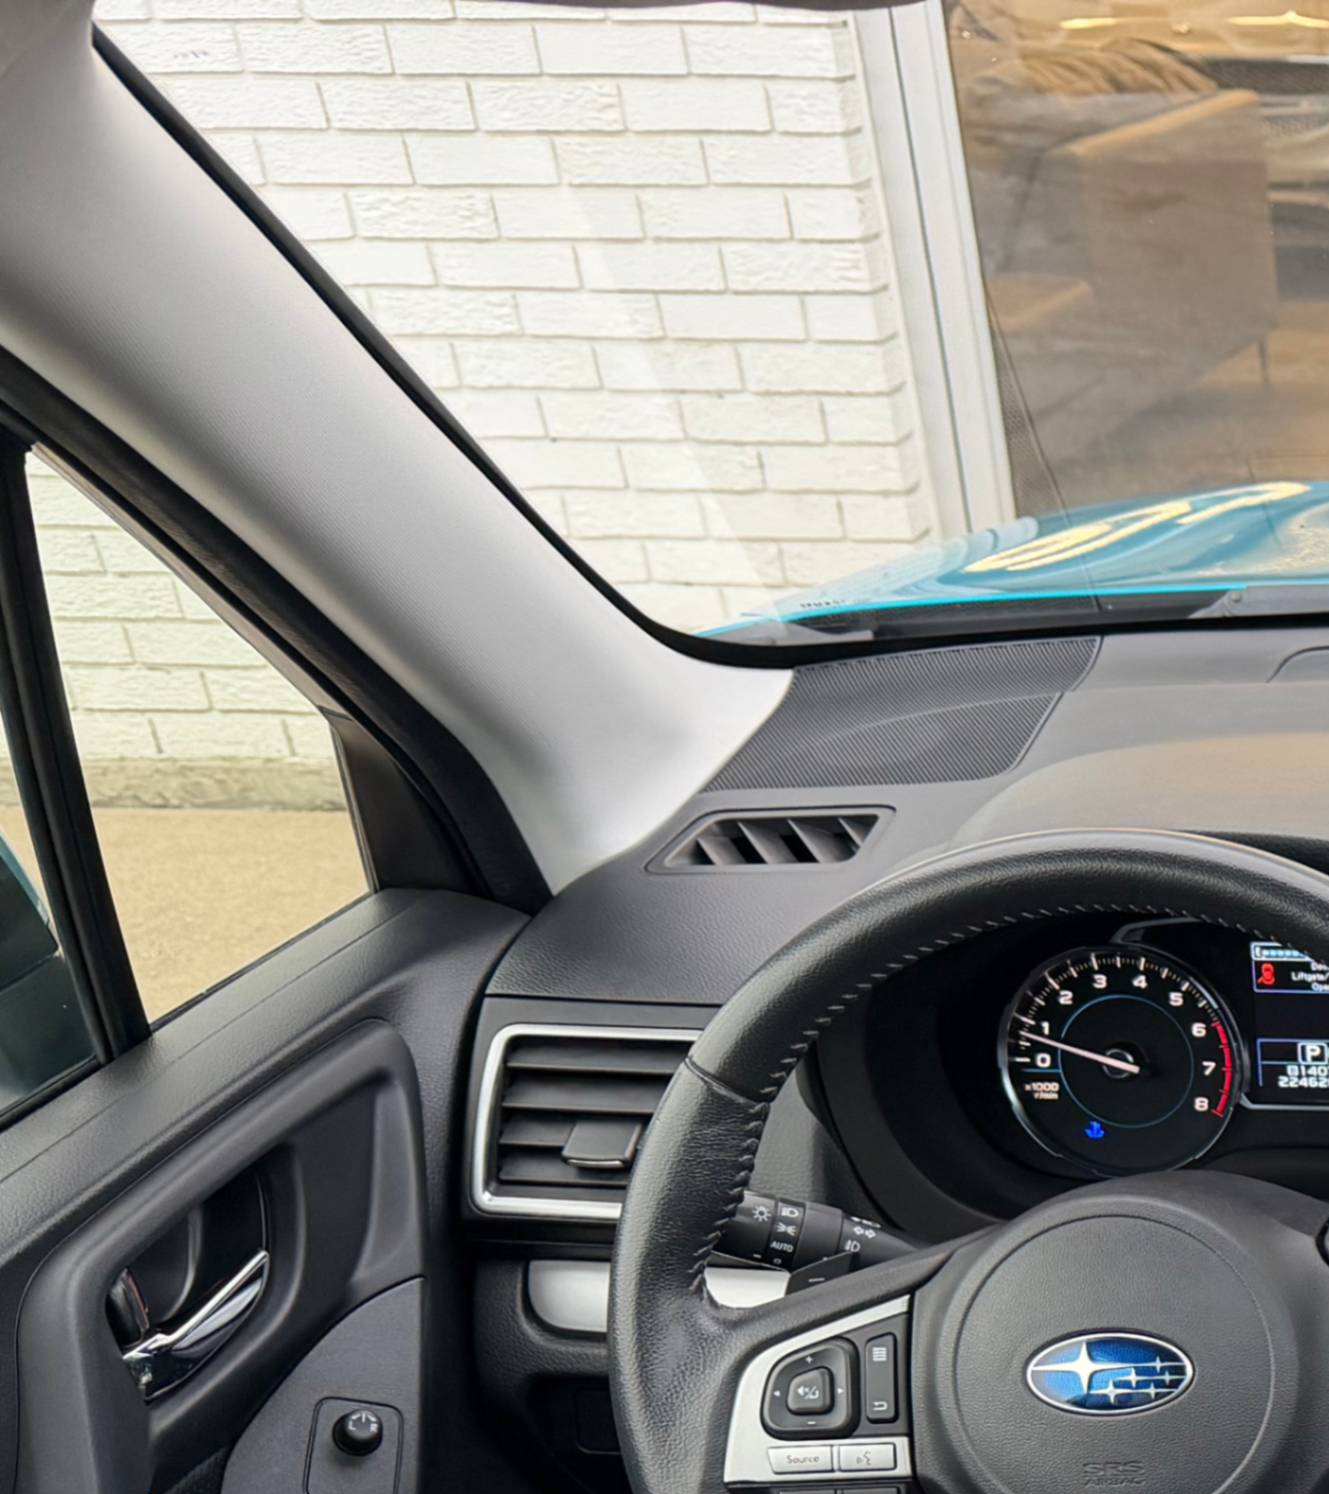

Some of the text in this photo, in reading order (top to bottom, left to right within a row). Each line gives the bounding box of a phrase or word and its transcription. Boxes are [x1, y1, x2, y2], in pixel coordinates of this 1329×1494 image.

[1093, 974, 1107, 989] 3
[1132, 974, 1147, 989] 4
[1058, 990, 1073, 1005] 2
[1168, 992, 1183, 1006] 5
[1041, 1021, 1050, 1036] 1
[1191, 1022, 1207, 1037] 6
[1036, 1053, 1051, 1068] 0
[1305, 1044, 1321, 1062] P
[1202, 1060, 1216, 1076] 7
[1194, 1097, 1209, 1112] 8
[770, 1240, 795, 1253] AUTO
[786, 1452, 821, 1465] Source
